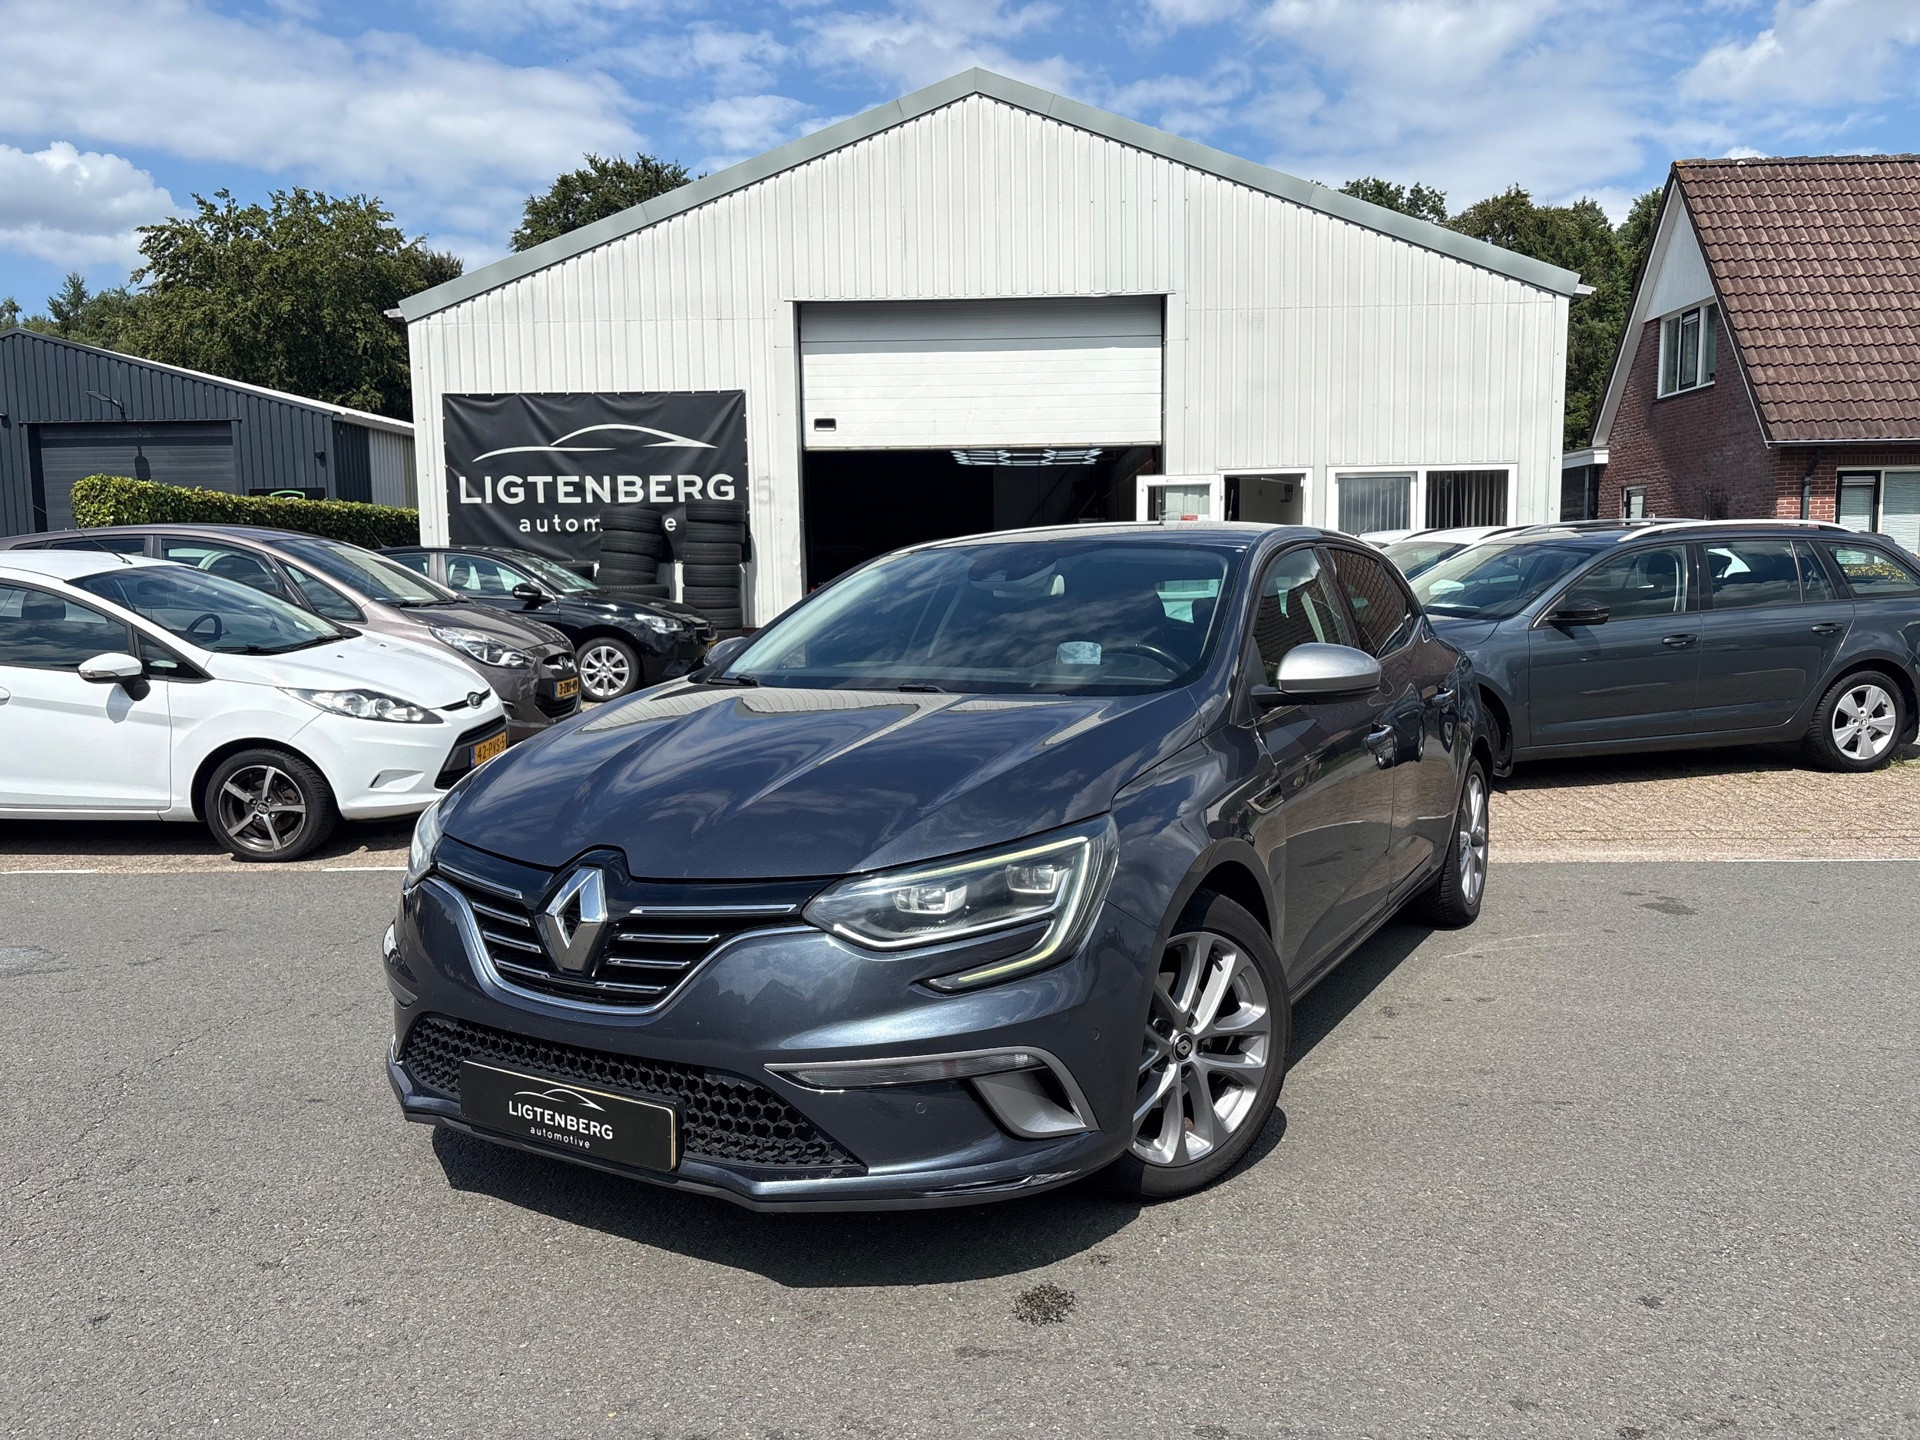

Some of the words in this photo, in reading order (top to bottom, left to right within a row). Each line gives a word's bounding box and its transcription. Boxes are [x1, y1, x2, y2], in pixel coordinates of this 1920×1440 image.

[458, 473, 736, 504] LIGTENBERG
[519, 513, 677, 532] autome
[508, 1100, 613, 1140] LIGTENBERG
[530, 1126, 590, 1149] automotive
